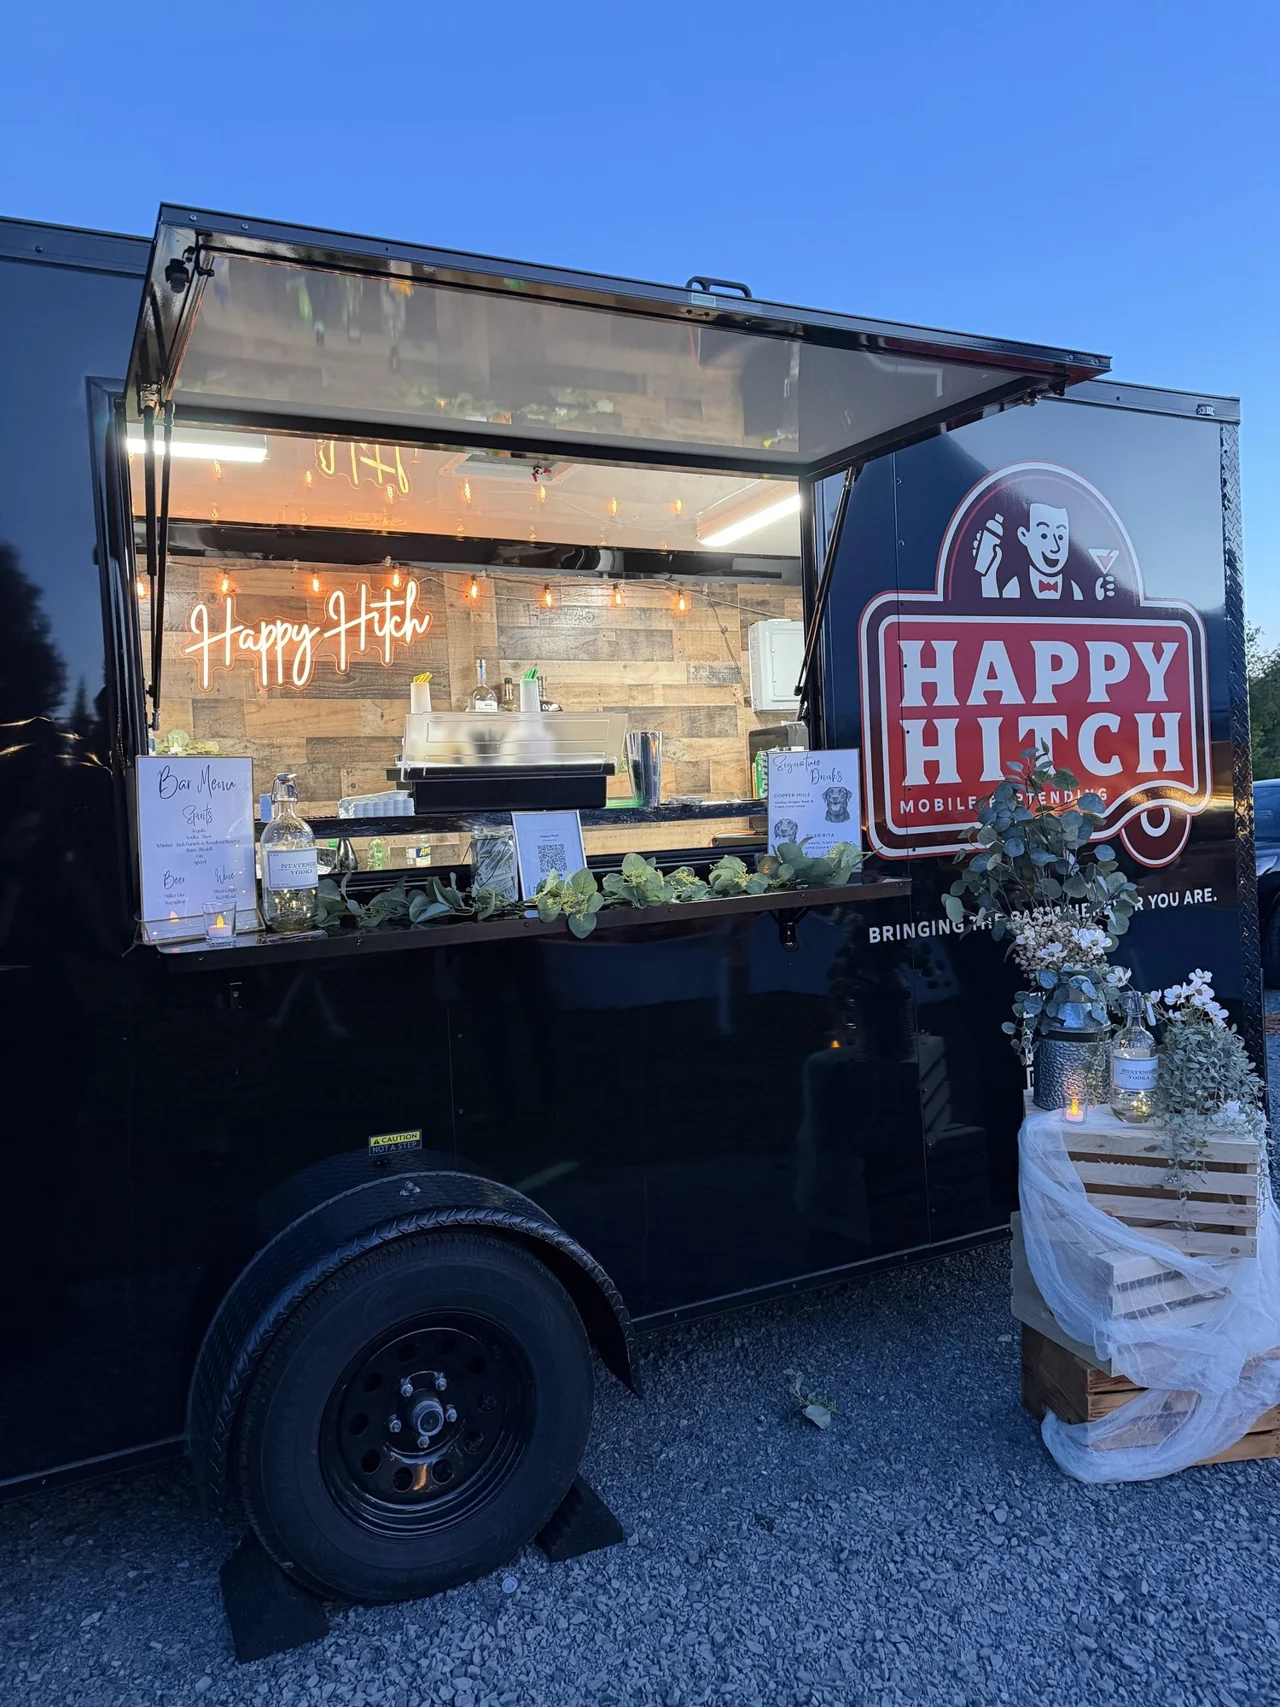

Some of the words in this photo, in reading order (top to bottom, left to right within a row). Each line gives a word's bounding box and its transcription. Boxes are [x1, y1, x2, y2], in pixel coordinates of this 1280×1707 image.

[185, 596, 321, 689] Happy
[323, 580, 431, 670] Hitch
[897, 640, 1180, 707] HAPPY
[899, 711, 1184, 786] HITCH
[773, 753, 821, 774] Signature
[158, 765, 192, 800] Bar
[197, 764, 236, 798] Menu
[810, 768, 844, 785] Drinks
[899, 796, 977, 814] MOBILE
[163, 869, 186, 890] Beer
[215, 865, 236, 885] Wine
[868, 917, 965, 944] BRINGING
[1147, 892, 1181, 911] YOU
[1183, 887, 1218, 905] ARE.
[372, 1144, 388, 1154] NOT
[398, 1141, 417, 1150] STEP
[381, 1132, 418, 1144] CAUTION
